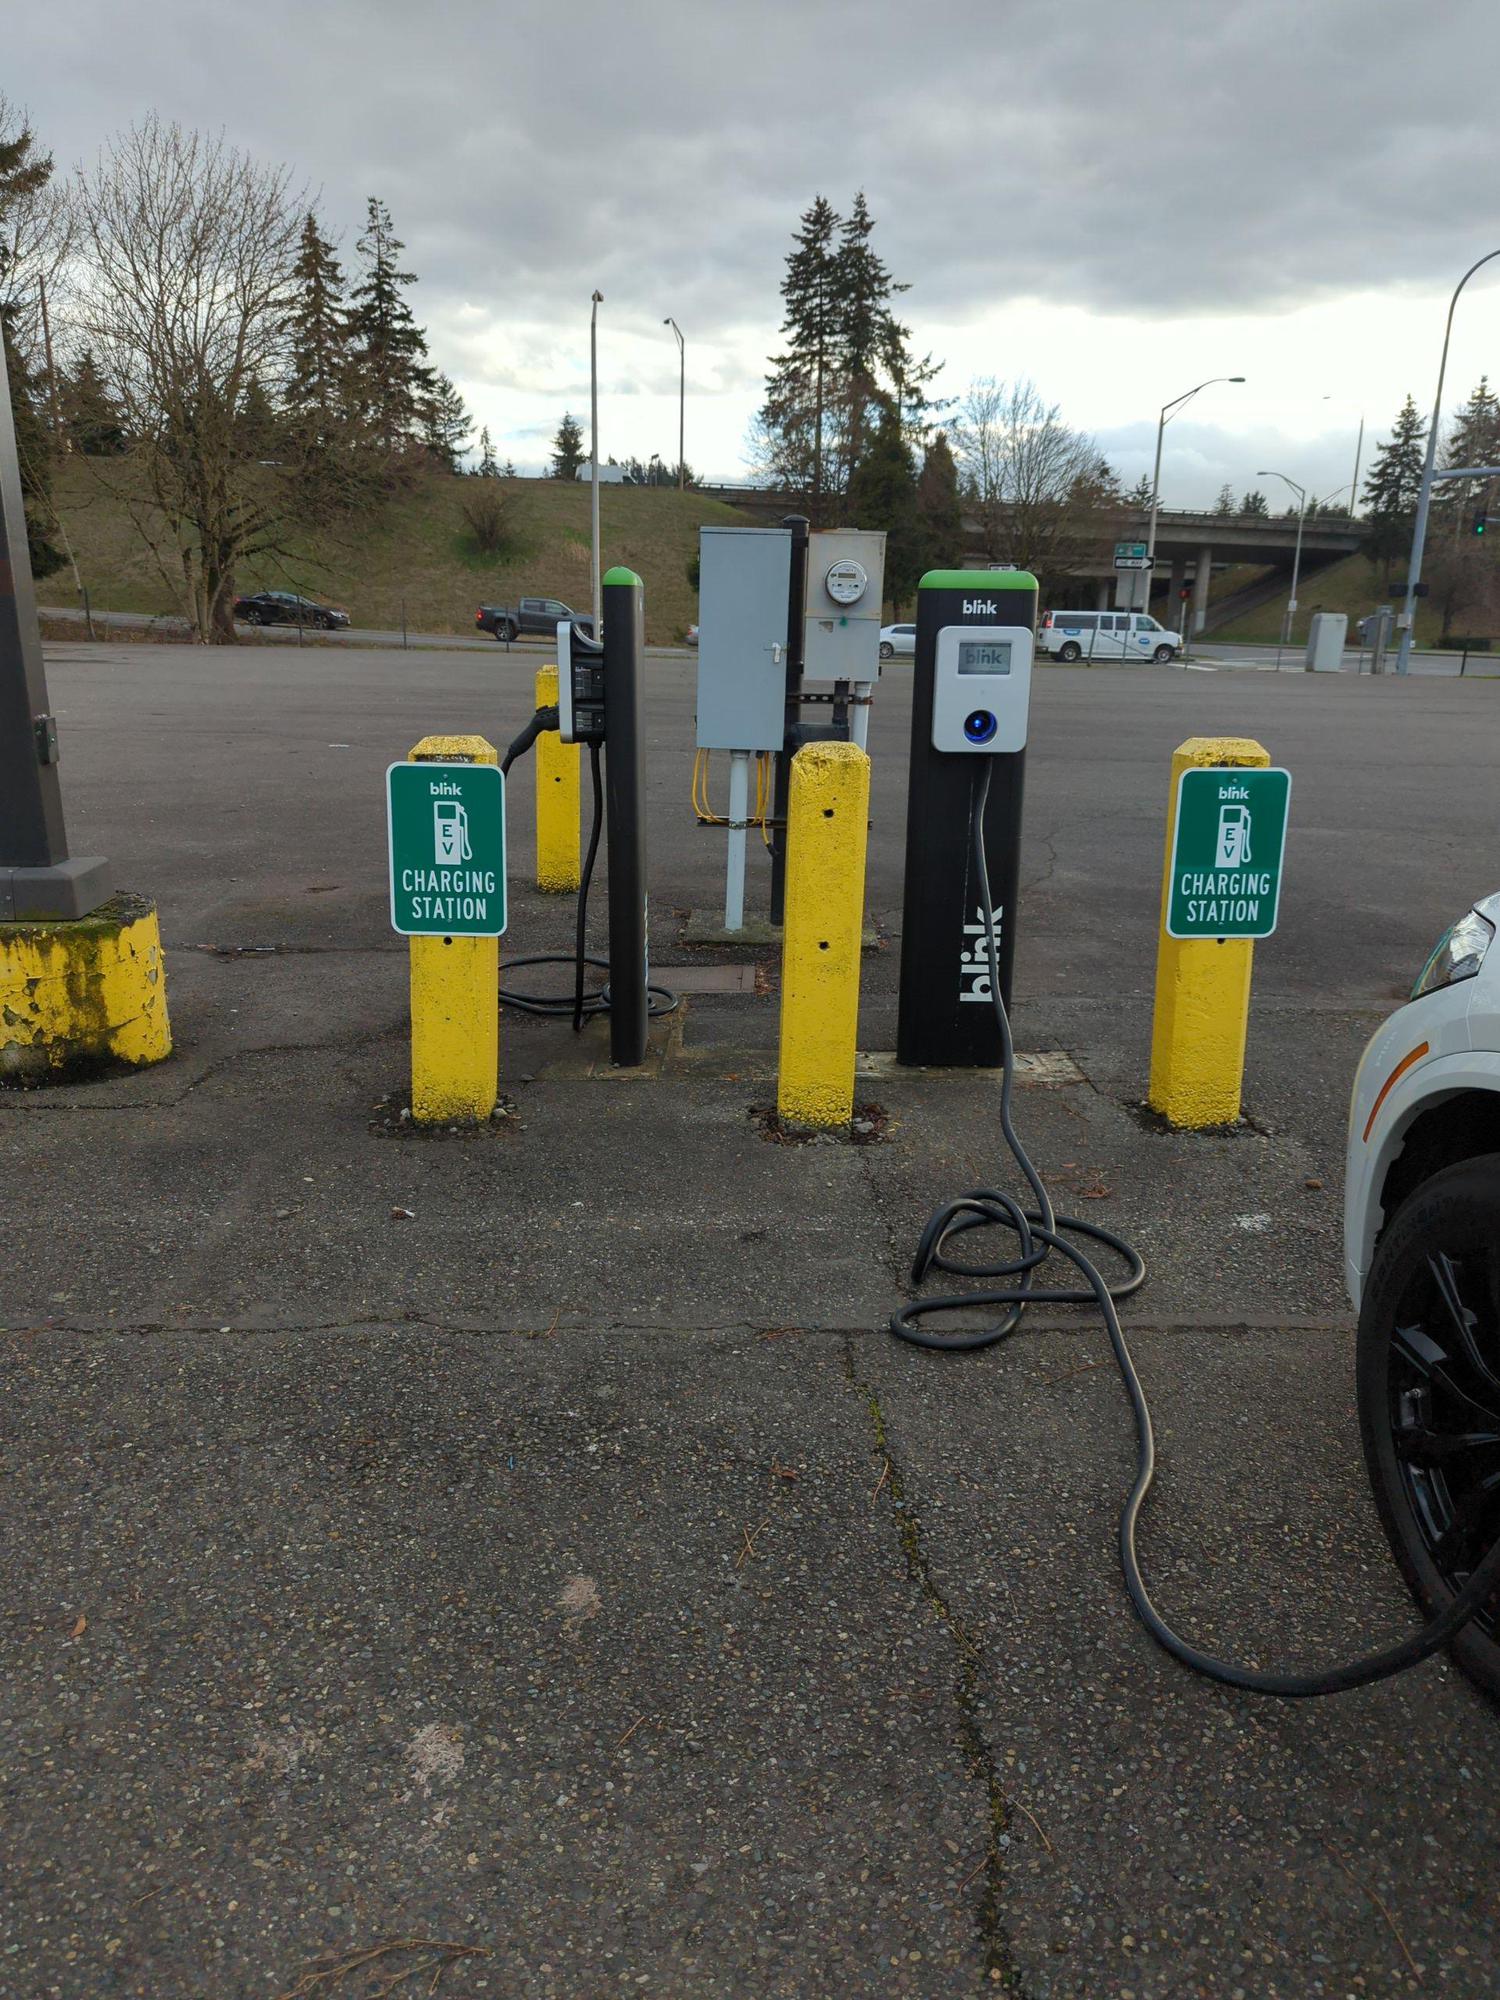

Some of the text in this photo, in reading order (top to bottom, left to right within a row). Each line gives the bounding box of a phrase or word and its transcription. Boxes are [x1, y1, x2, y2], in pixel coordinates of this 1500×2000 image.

[962, 599, 998, 614] blink
[966, 649, 1002, 664] blink
[430, 782, 463, 796] blink
[1218, 787, 1250, 800] blink
[402, 869, 495, 893] CHARGING
[1181, 873, 1270, 895] CHARGING
[412, 897, 487, 920] STATION
[1187, 900, 1259, 922] STATION
[959, 905, 1003, 1002] blink
